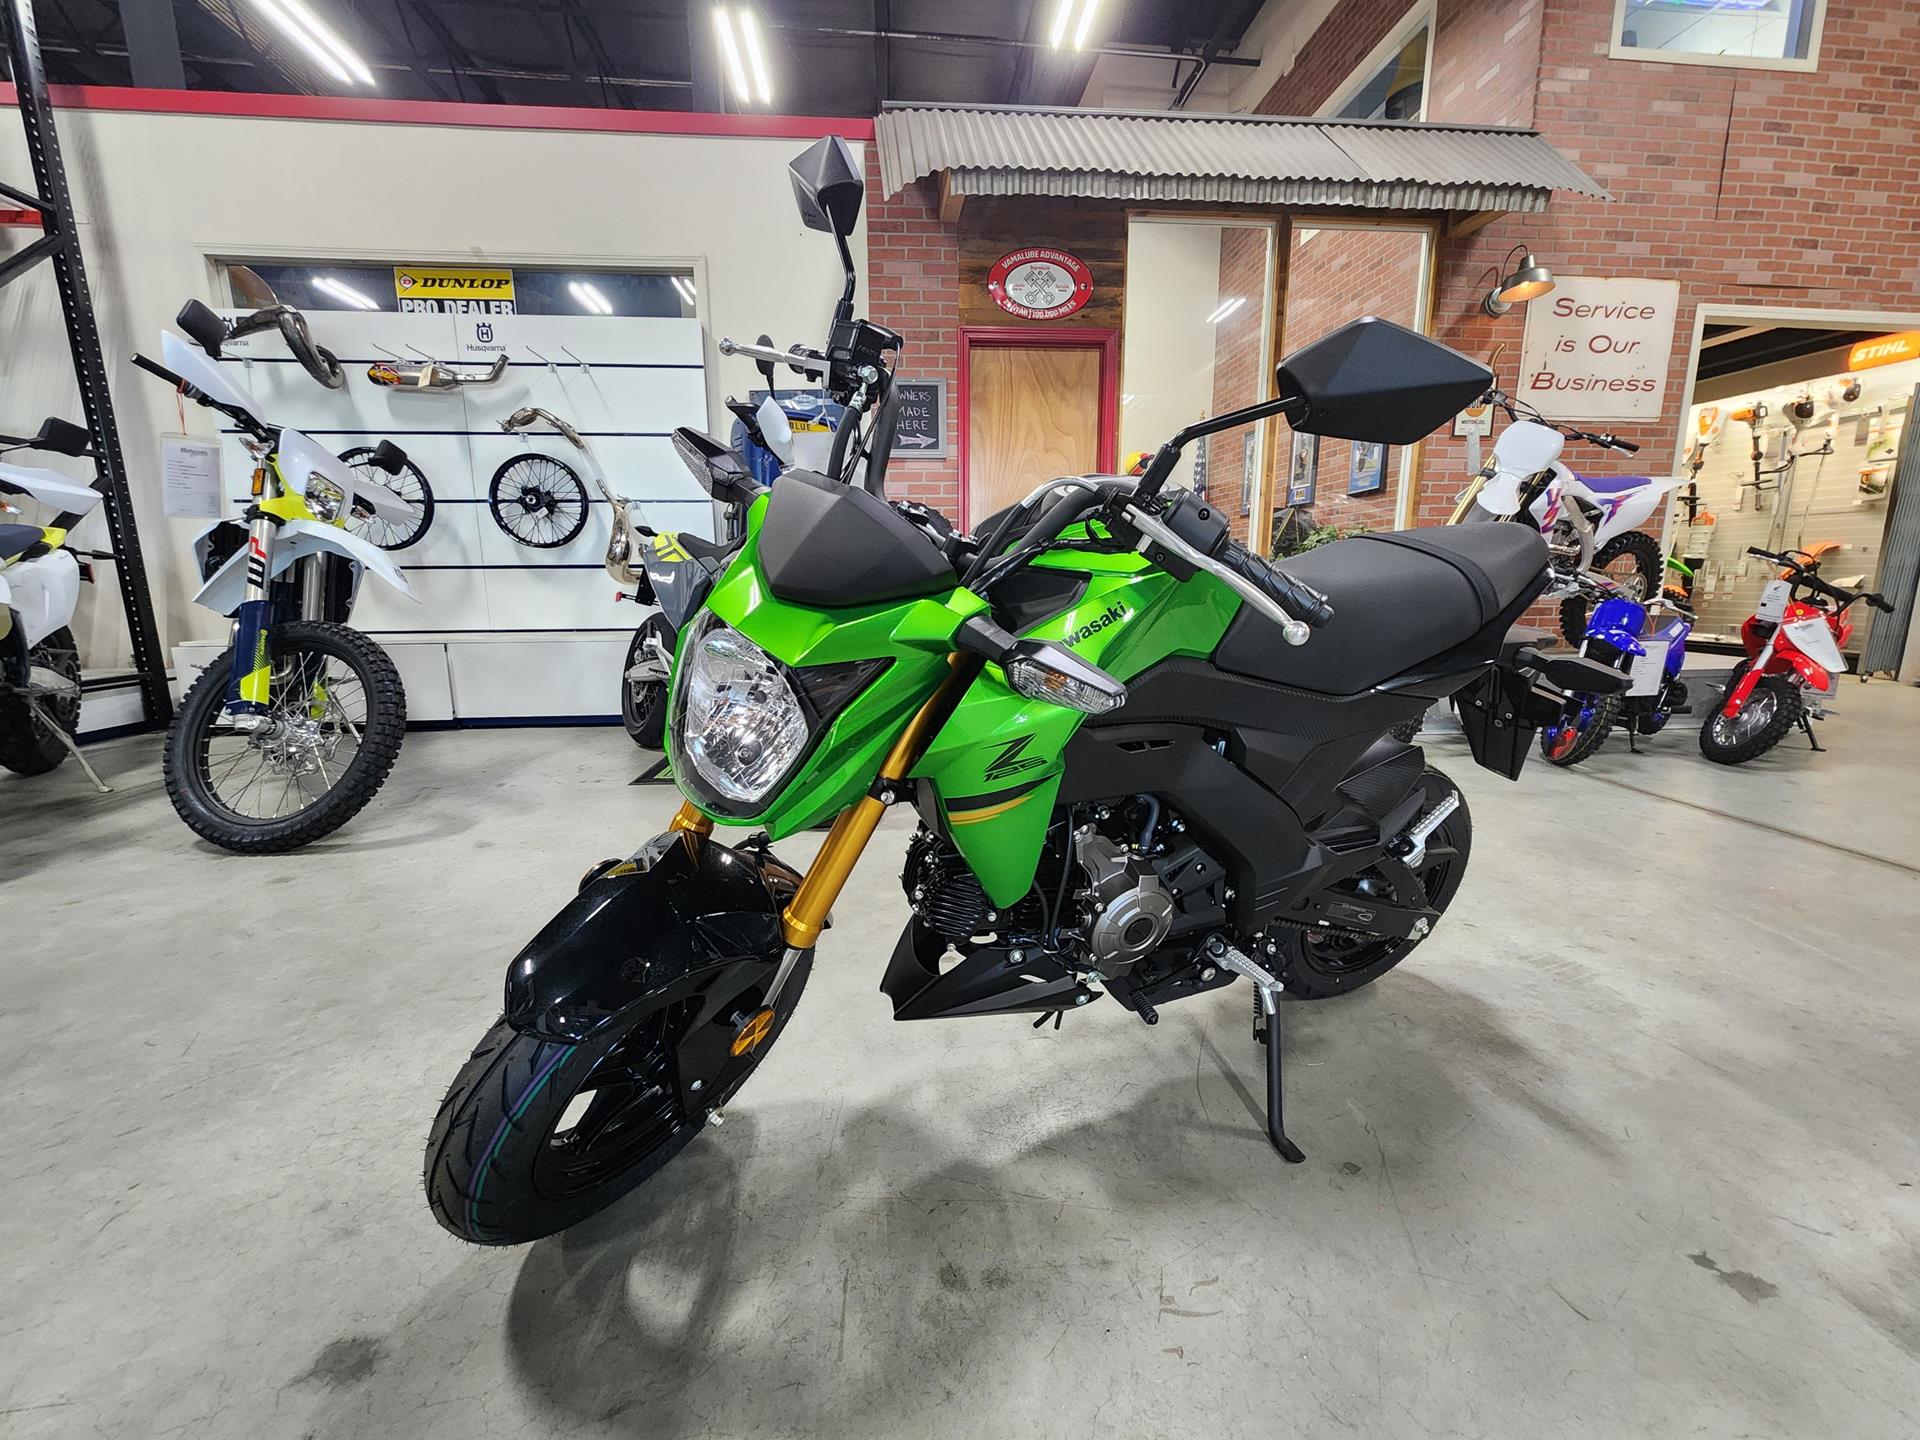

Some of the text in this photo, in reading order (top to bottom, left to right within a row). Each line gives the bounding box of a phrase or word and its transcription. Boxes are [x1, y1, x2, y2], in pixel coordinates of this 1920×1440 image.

[1040, 250, 1081, 272] ADVANTAGE
[420, 277, 511, 289] DUNLOP
[401, 300, 515, 316] PRO DEALER
[1553, 297, 1656, 320] Service
[222, 339, 249, 348] qvarna
[466, 344, 506, 353] Husqvarna
[1554, 335, 1641, 354] is Our
[1852, 340, 1910, 363] STIHL
[1530, 372, 1657, 392] Business
[899, 389, 931, 401] WNERS
[896, 420, 928, 430] HERE
[1061, 600, 1128, 648] wasaki
[983, 757, 1048, 783] 125
